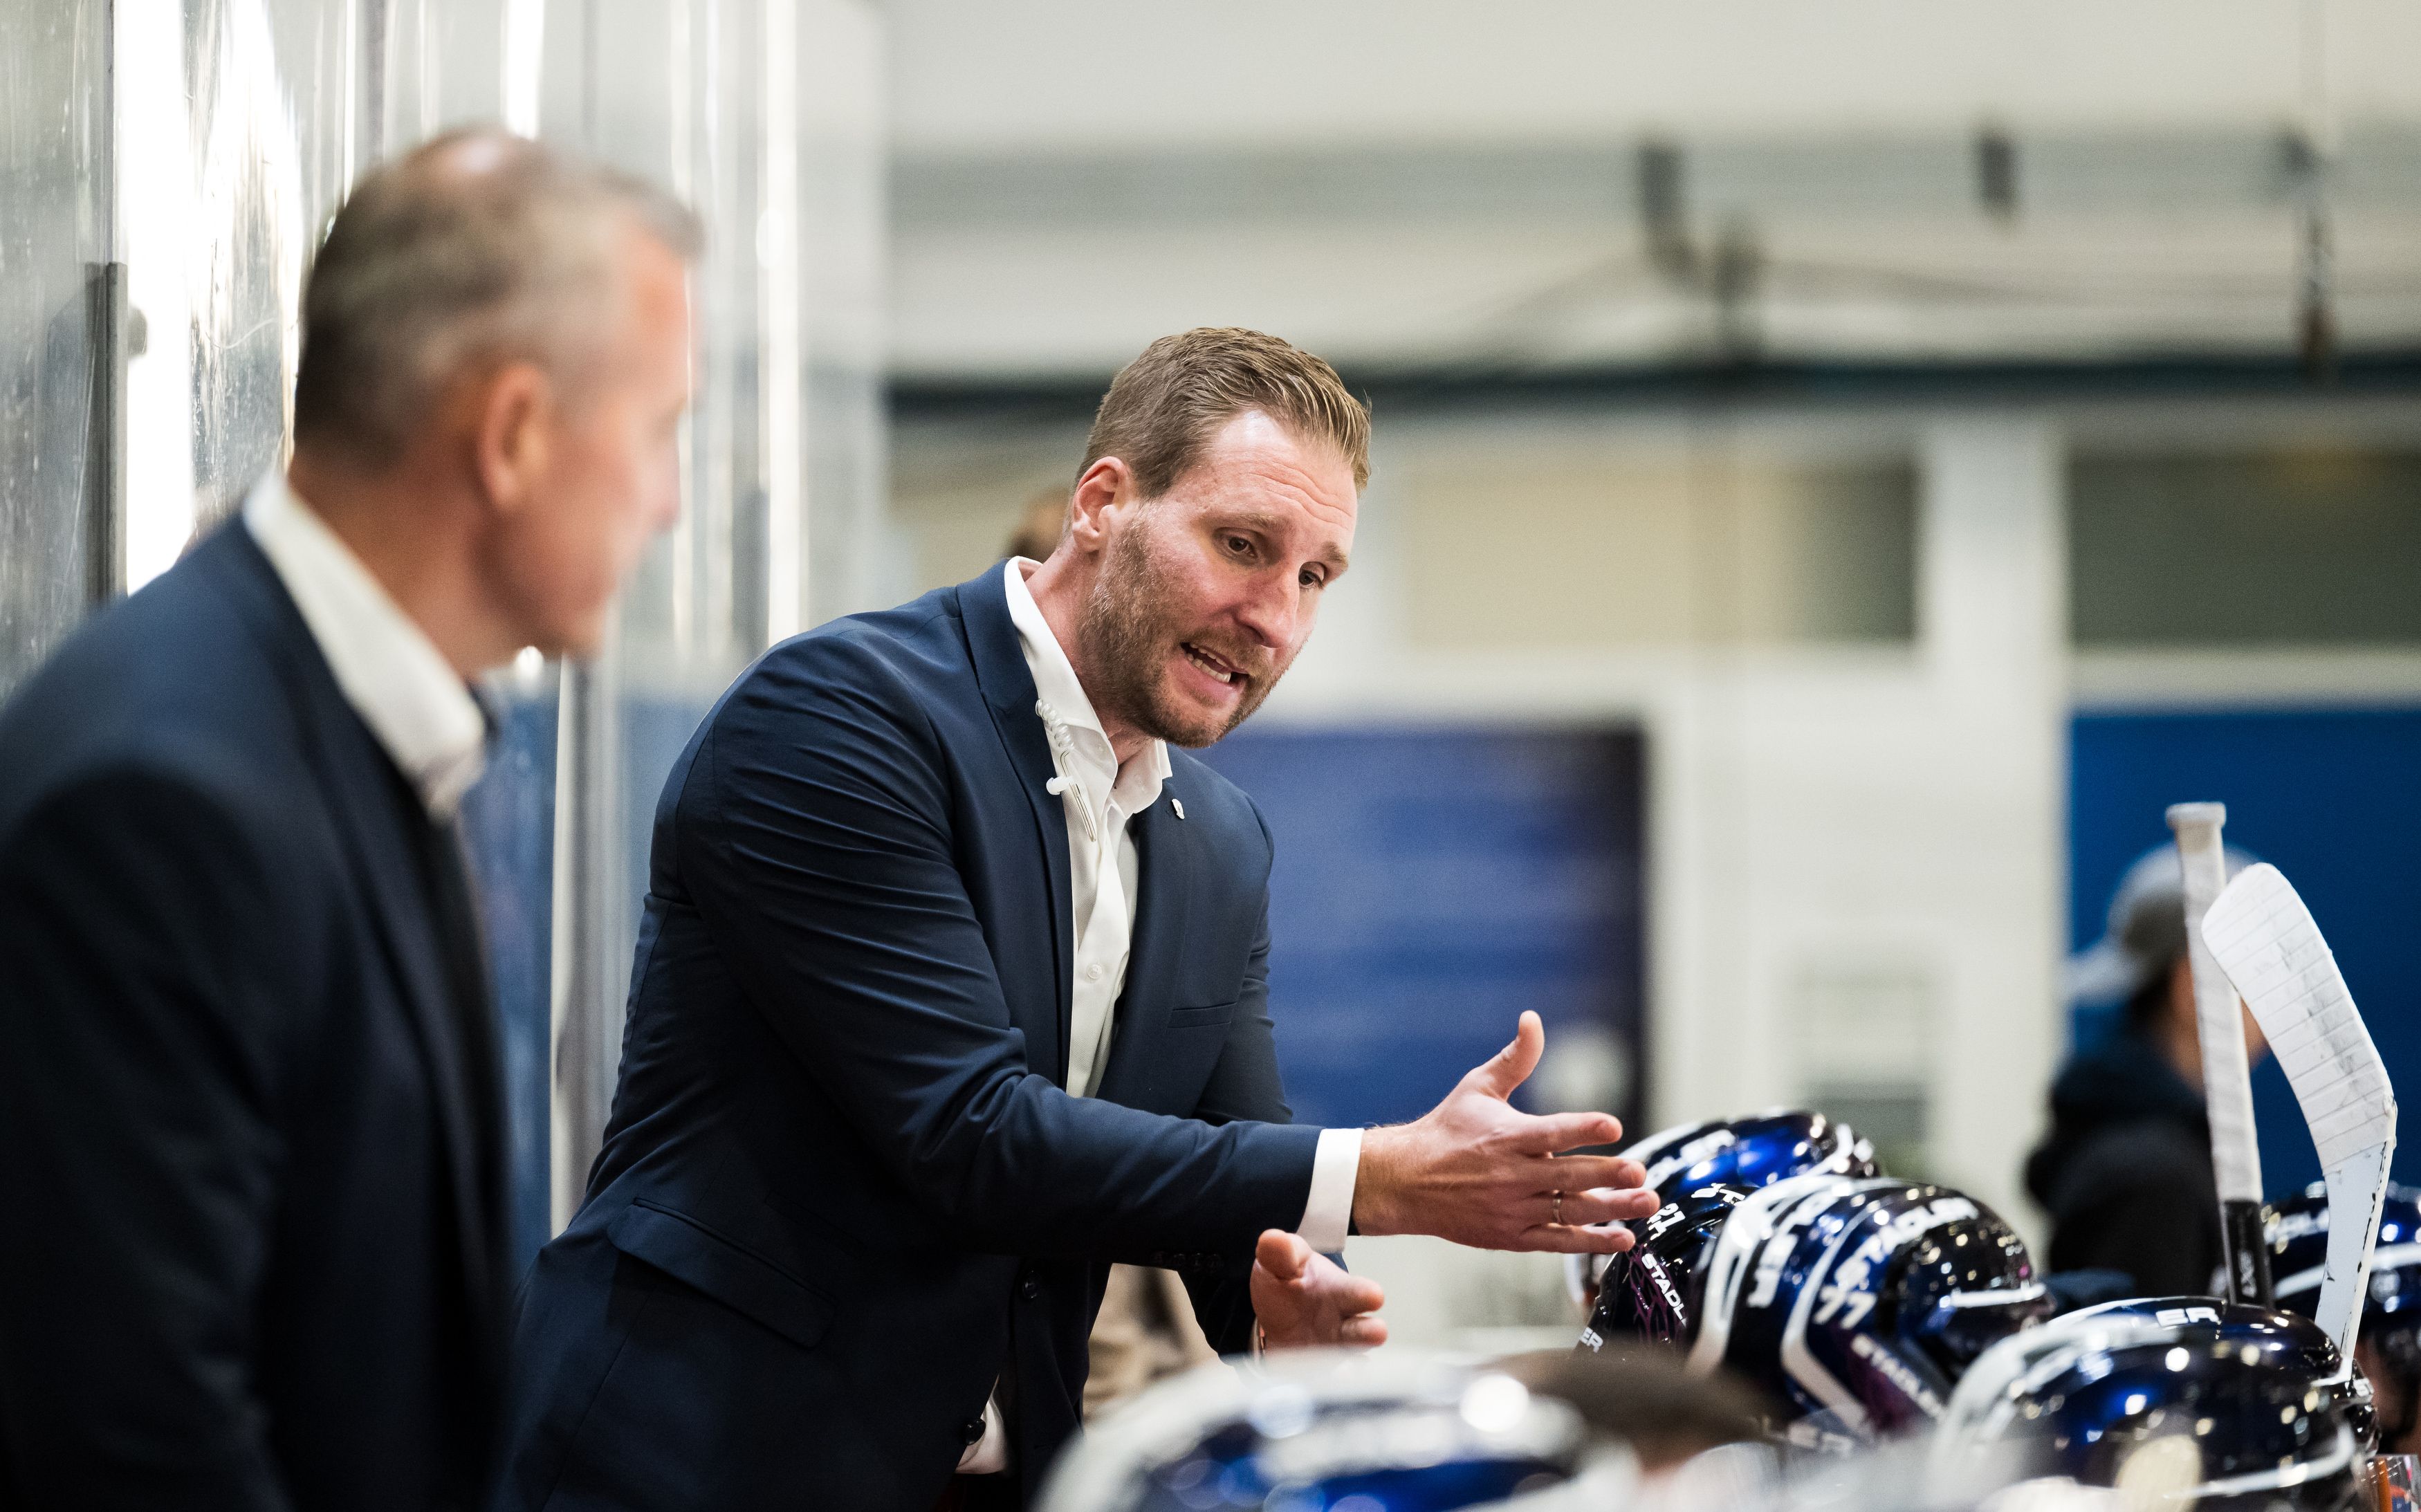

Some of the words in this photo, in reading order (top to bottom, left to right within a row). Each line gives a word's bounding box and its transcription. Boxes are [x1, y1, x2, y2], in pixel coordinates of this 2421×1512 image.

[1646, 1202, 1686, 1241] 21
[1641, 1253, 1688, 1328] STADL
[1812, 1284, 1877, 1330] 77
